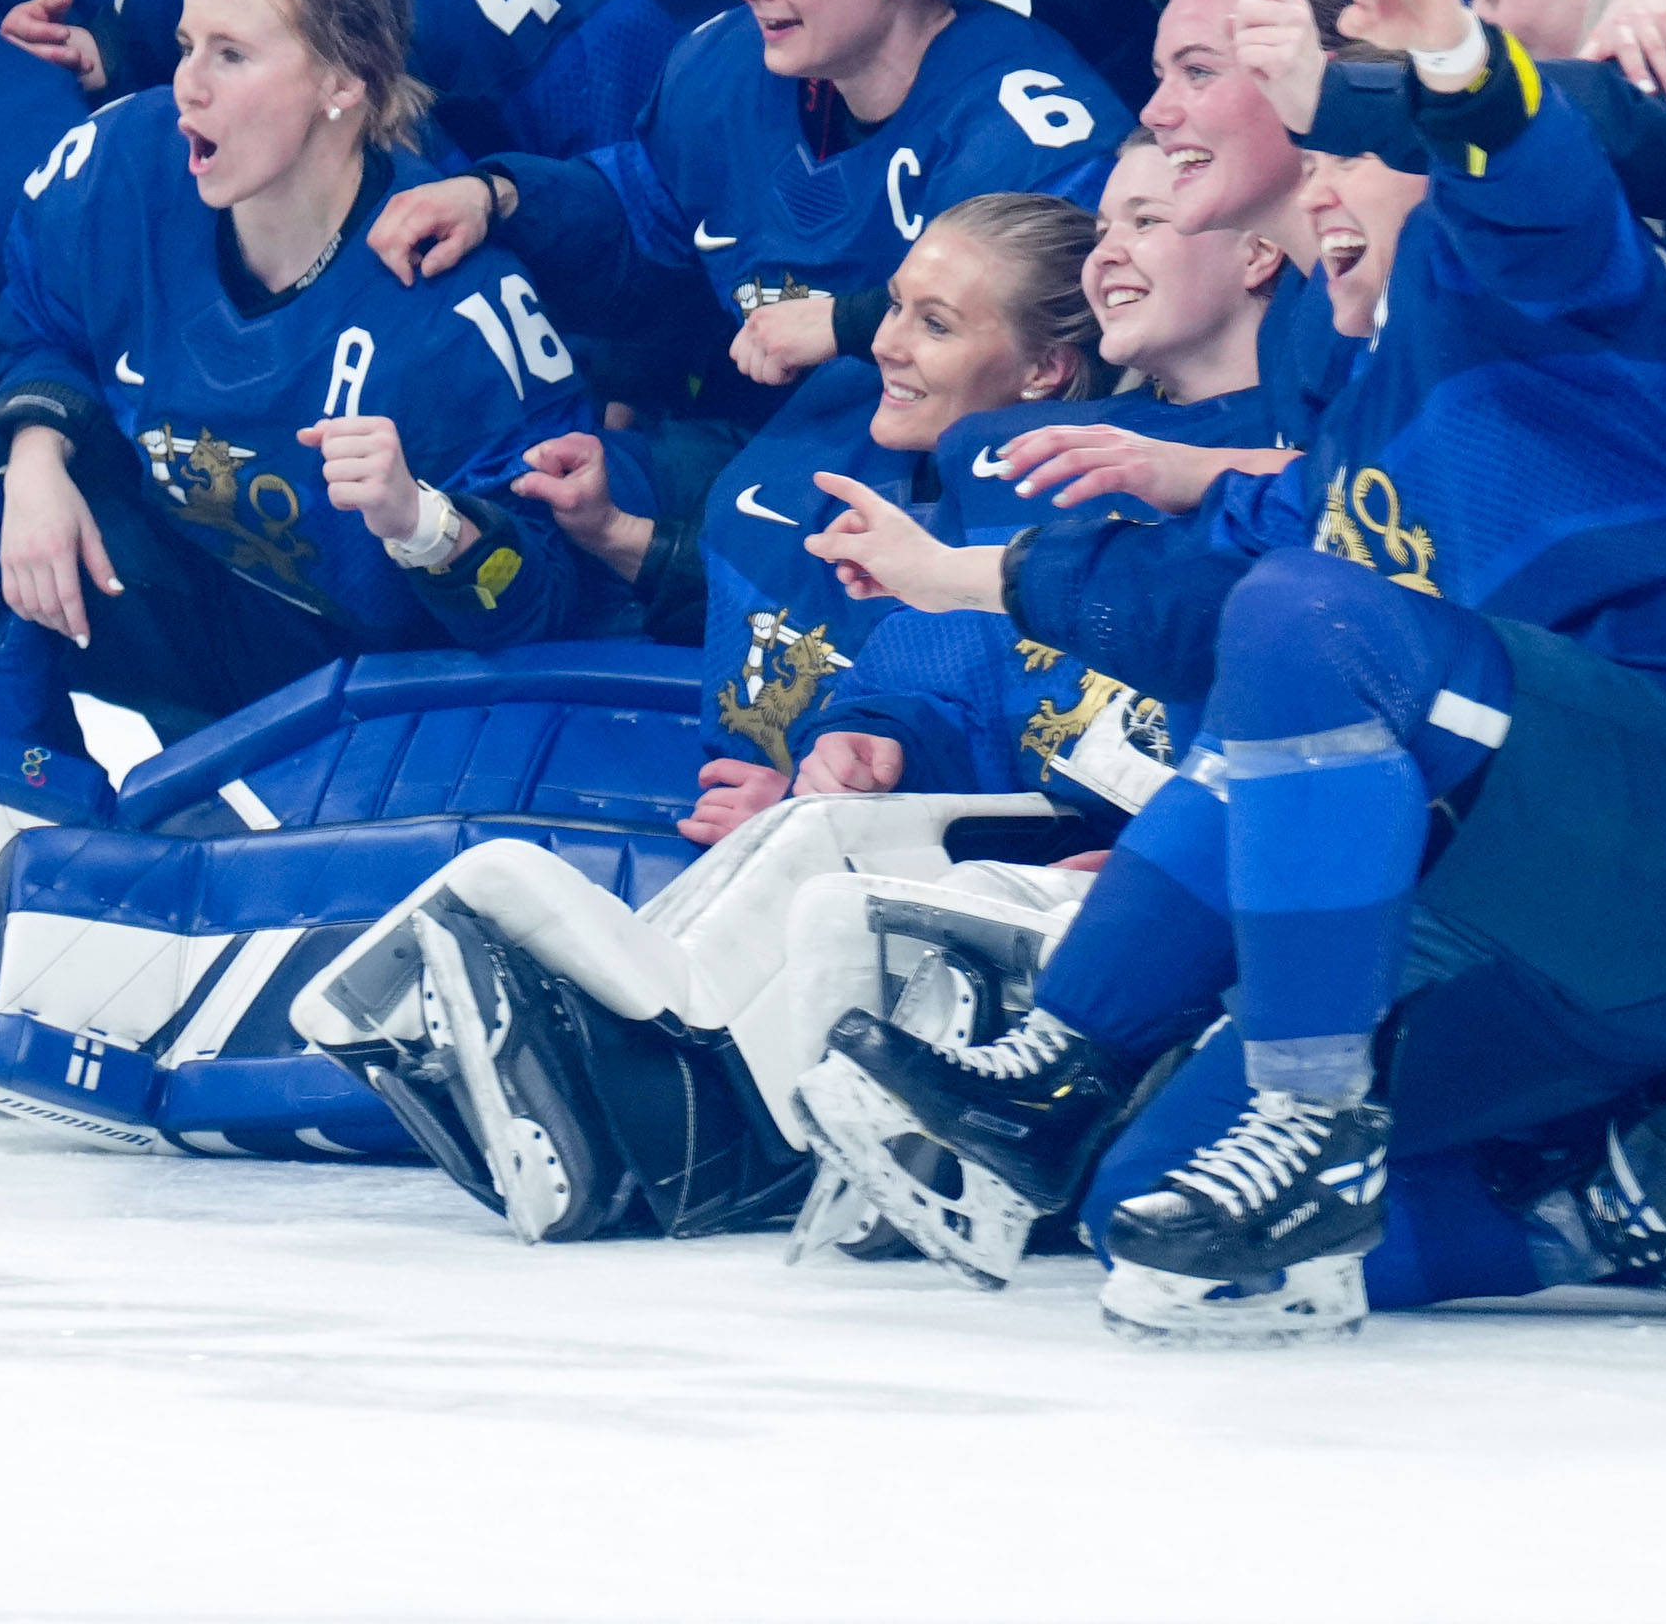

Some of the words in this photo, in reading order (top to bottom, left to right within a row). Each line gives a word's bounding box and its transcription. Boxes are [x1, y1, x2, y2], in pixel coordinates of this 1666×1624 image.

[998, 68, 1095, 149] 6
[886, 147, 923, 242] C
[324, 325, 376, 418] A
[453, 272, 576, 401] 16
